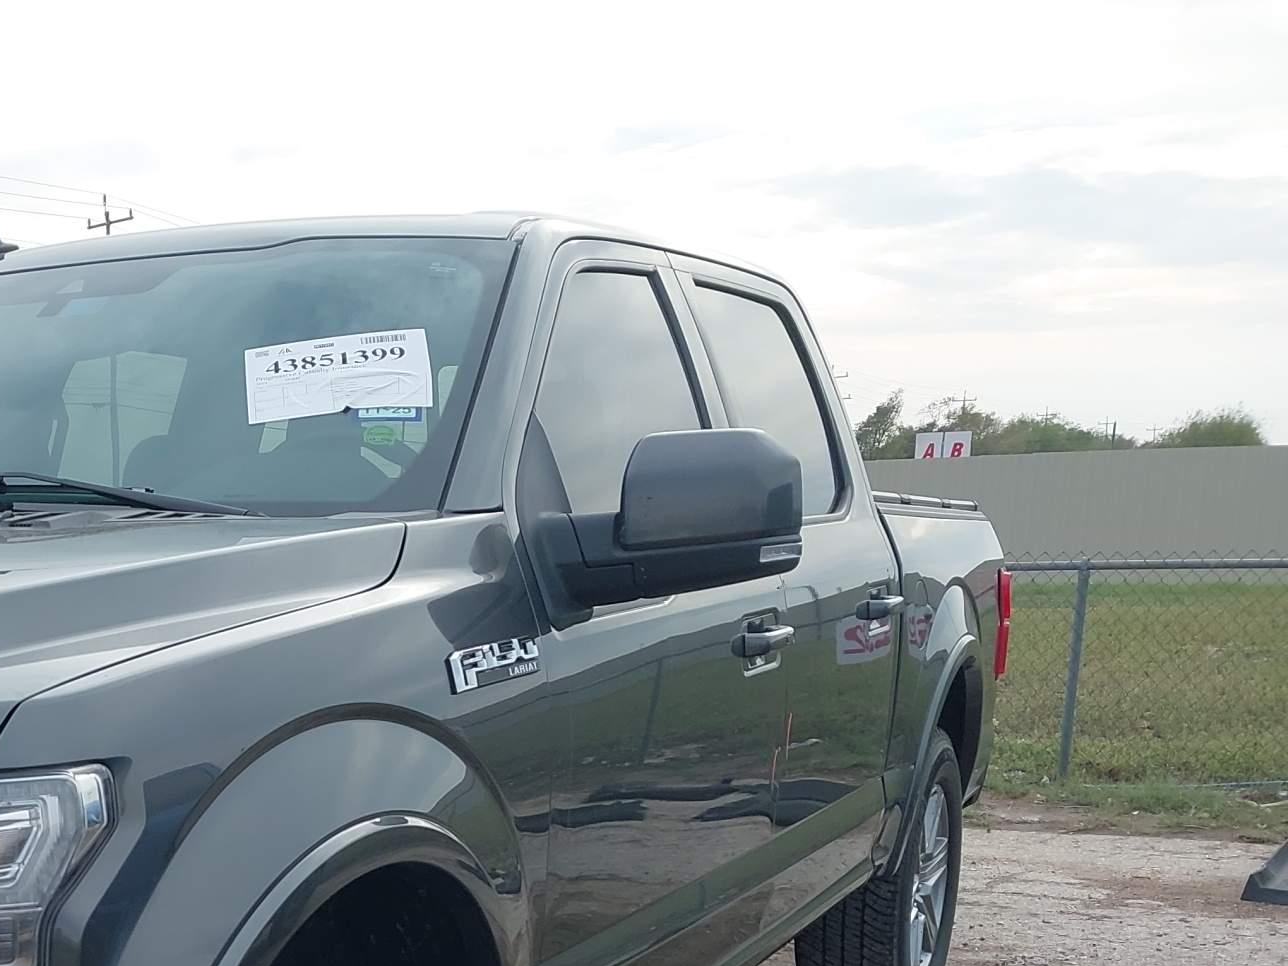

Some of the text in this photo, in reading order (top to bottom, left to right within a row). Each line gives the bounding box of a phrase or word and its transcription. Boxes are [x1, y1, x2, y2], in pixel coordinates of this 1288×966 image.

[265, 346, 406, 374] 43851399
[923, 442, 964, 459] A B
[509, 661, 538, 676] LARIAT
